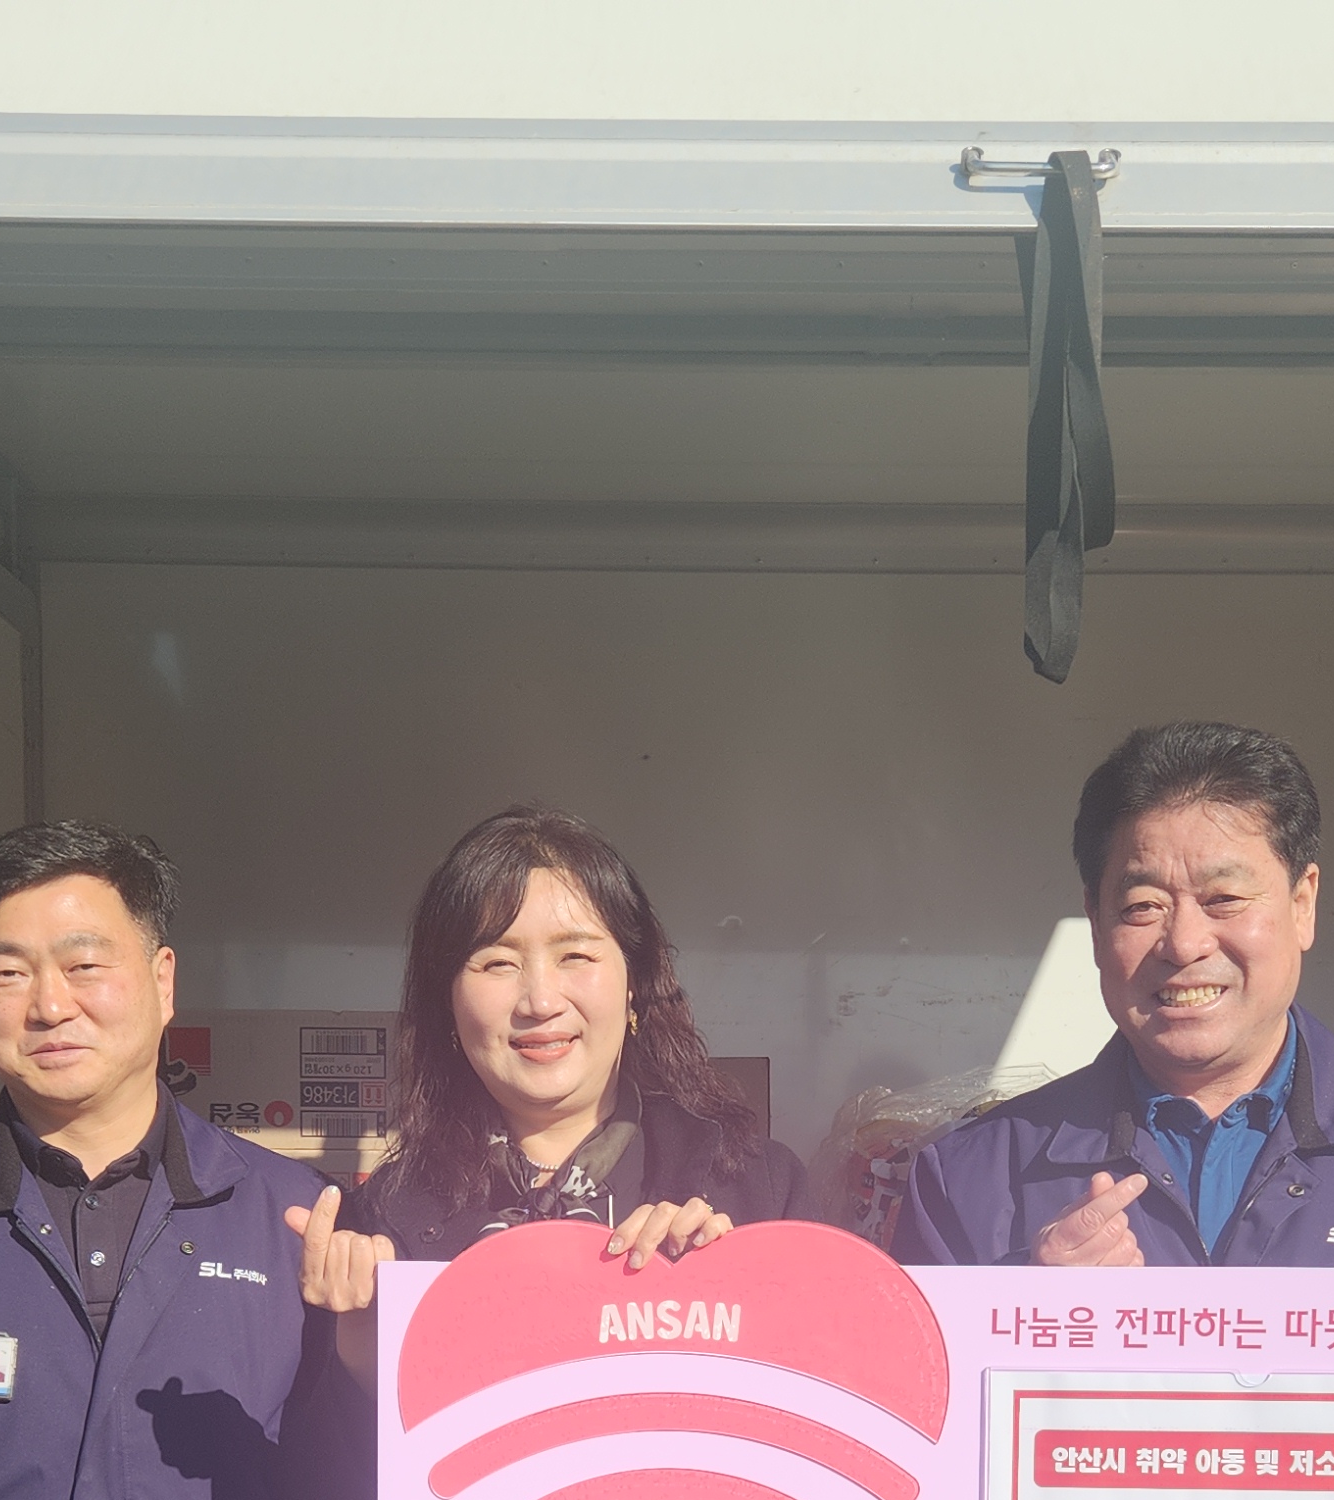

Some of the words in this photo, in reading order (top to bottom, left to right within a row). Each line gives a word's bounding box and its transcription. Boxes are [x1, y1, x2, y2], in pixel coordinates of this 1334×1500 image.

[303, 1084, 357, 1104] 가3486
[210, 1102, 260, 1123] 농심
[198, 1261, 233, 1279] SL
[233, 1268, 268, 1286] 주식회사
[599, 1300, 742, 1344] ANSAN
[990, 1306, 1099, 1349] 나눔을
[1114, 1306, 1267, 1350] 전파하는
[1052, 1446, 1126, 1474] 안산시
[1135, 1447, 1187, 1475] 취약
[1195, 1448, 1246, 1476] 아동
[1254, 1448, 1279, 1477] 및
